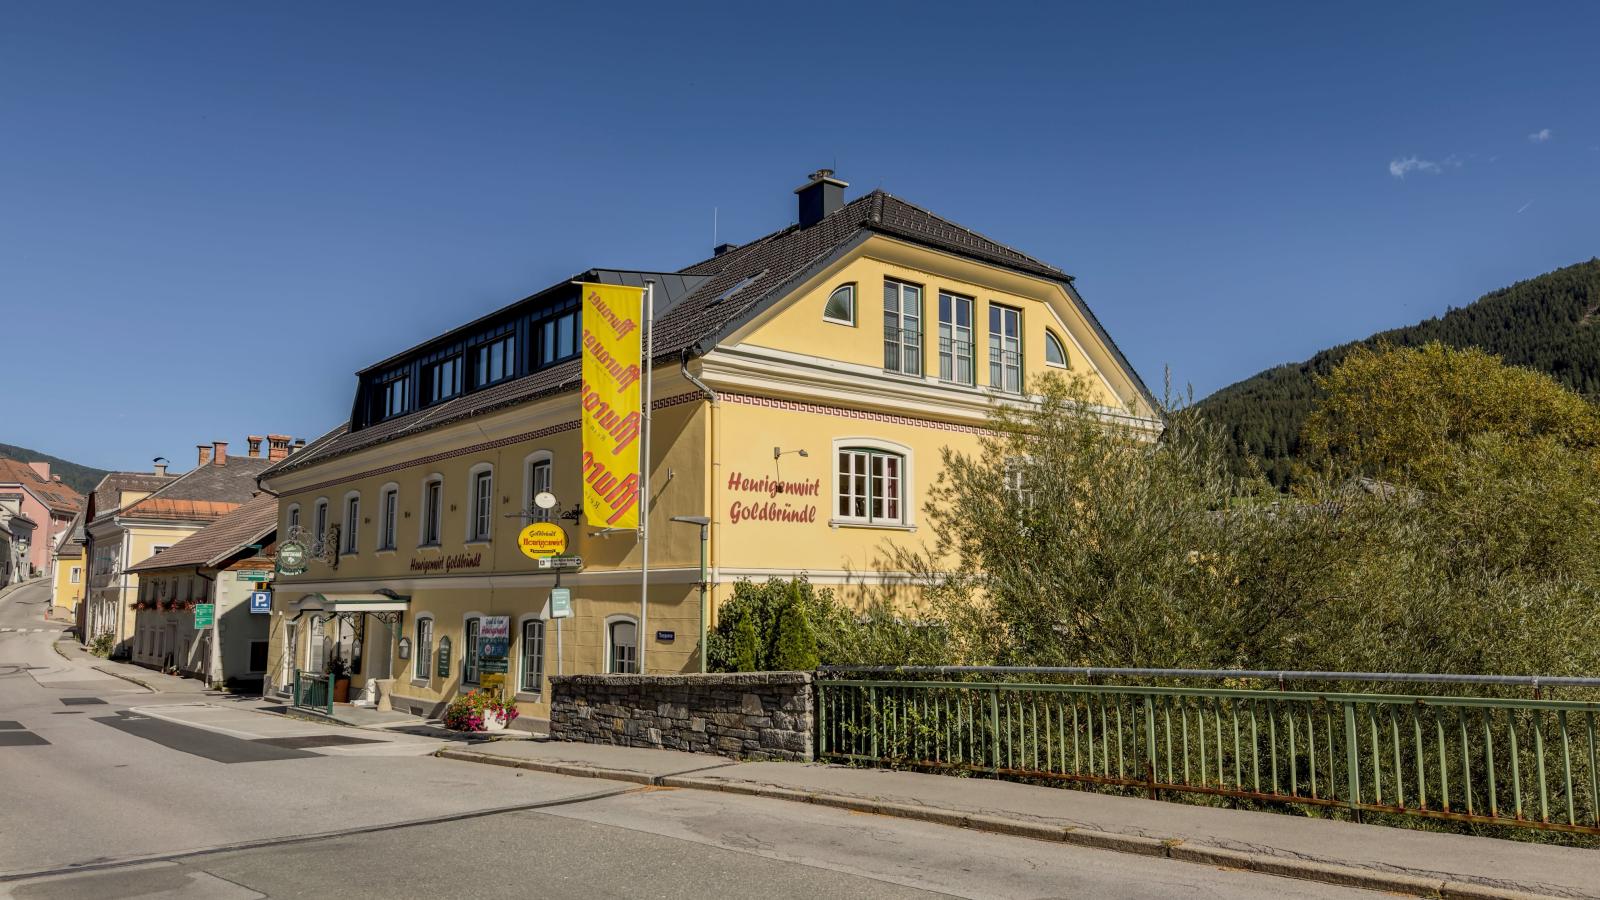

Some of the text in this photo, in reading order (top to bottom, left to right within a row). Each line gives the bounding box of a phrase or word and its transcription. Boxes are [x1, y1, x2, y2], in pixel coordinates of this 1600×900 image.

[728, 471, 820, 499] Heurigenwirt
[730, 500, 816, 524] Goldbründl
[410, 552, 482, 575] Heurigenwirt Goldbründl
[255, 593, 267, 607] P
